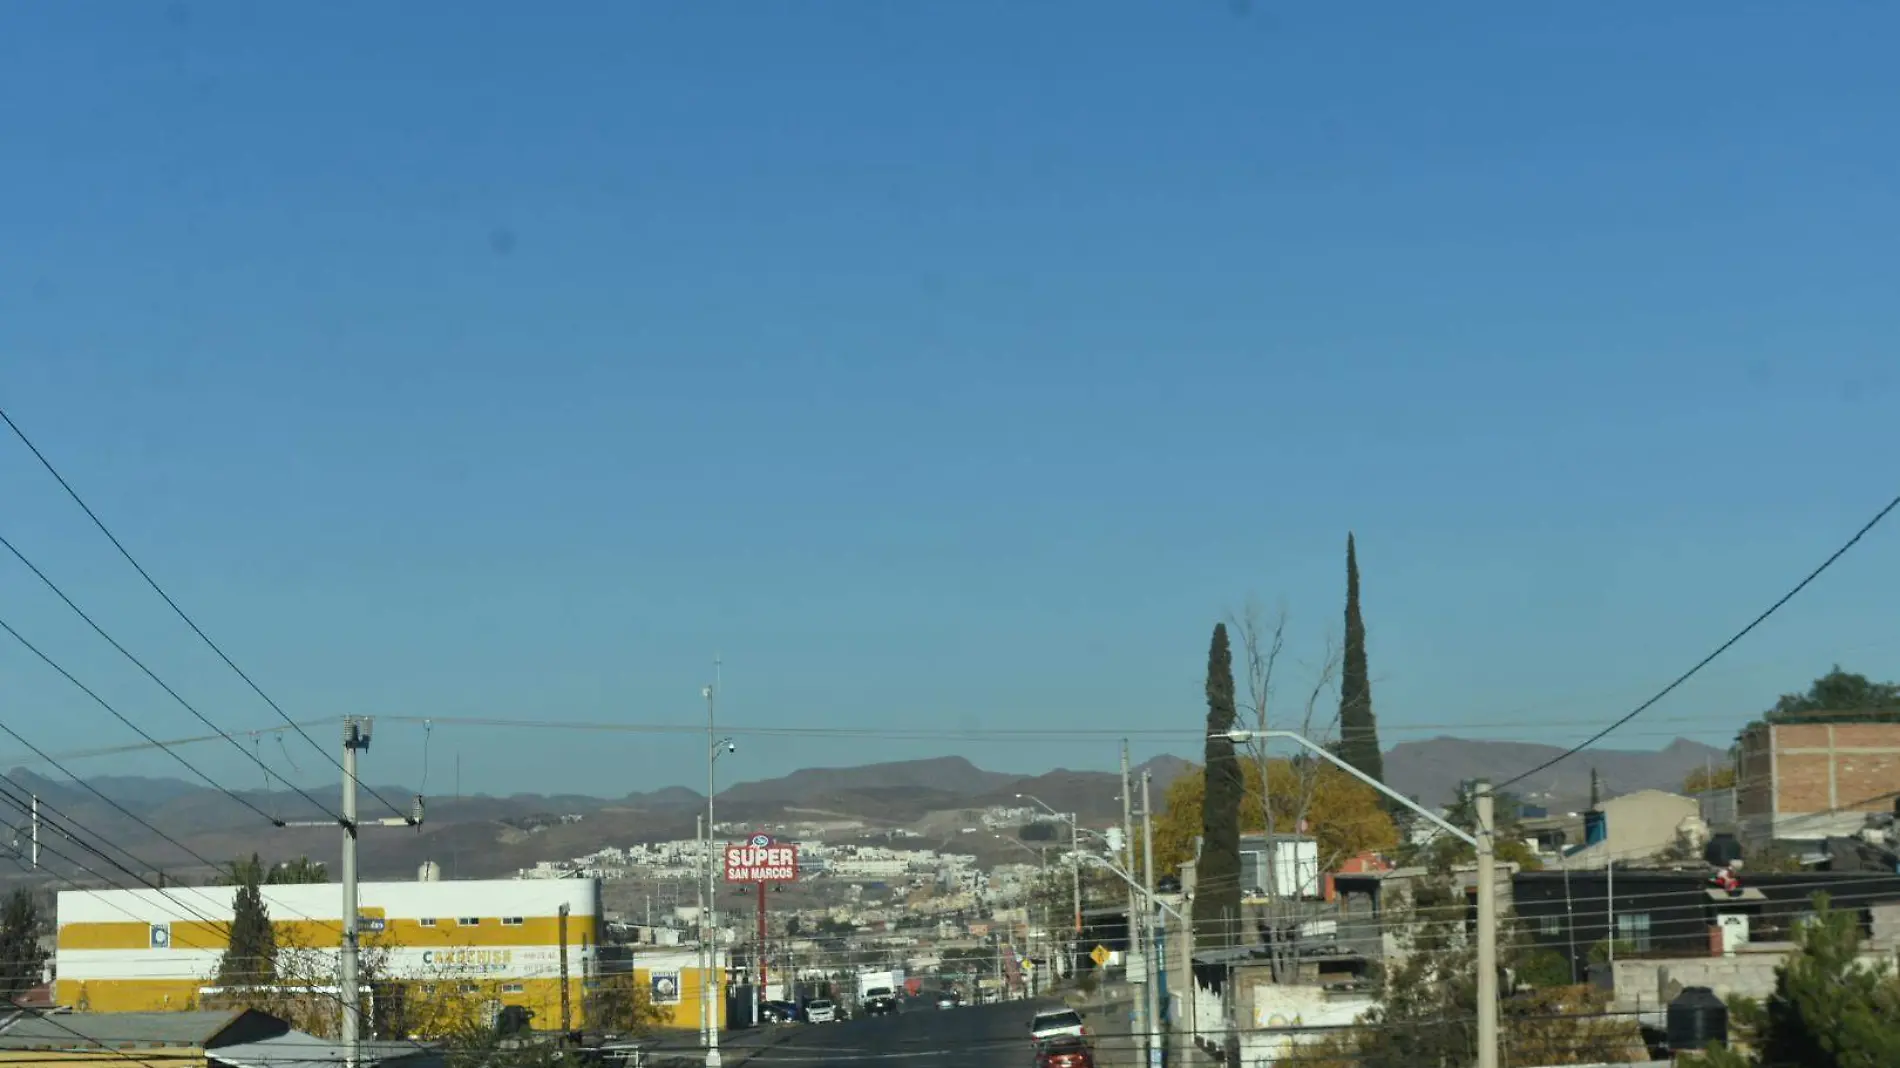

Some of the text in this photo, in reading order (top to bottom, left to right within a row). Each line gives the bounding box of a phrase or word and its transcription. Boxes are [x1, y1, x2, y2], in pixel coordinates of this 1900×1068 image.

[728, 849, 793, 866] SUPER
[728, 867, 793, 879] SAN MARCOS
